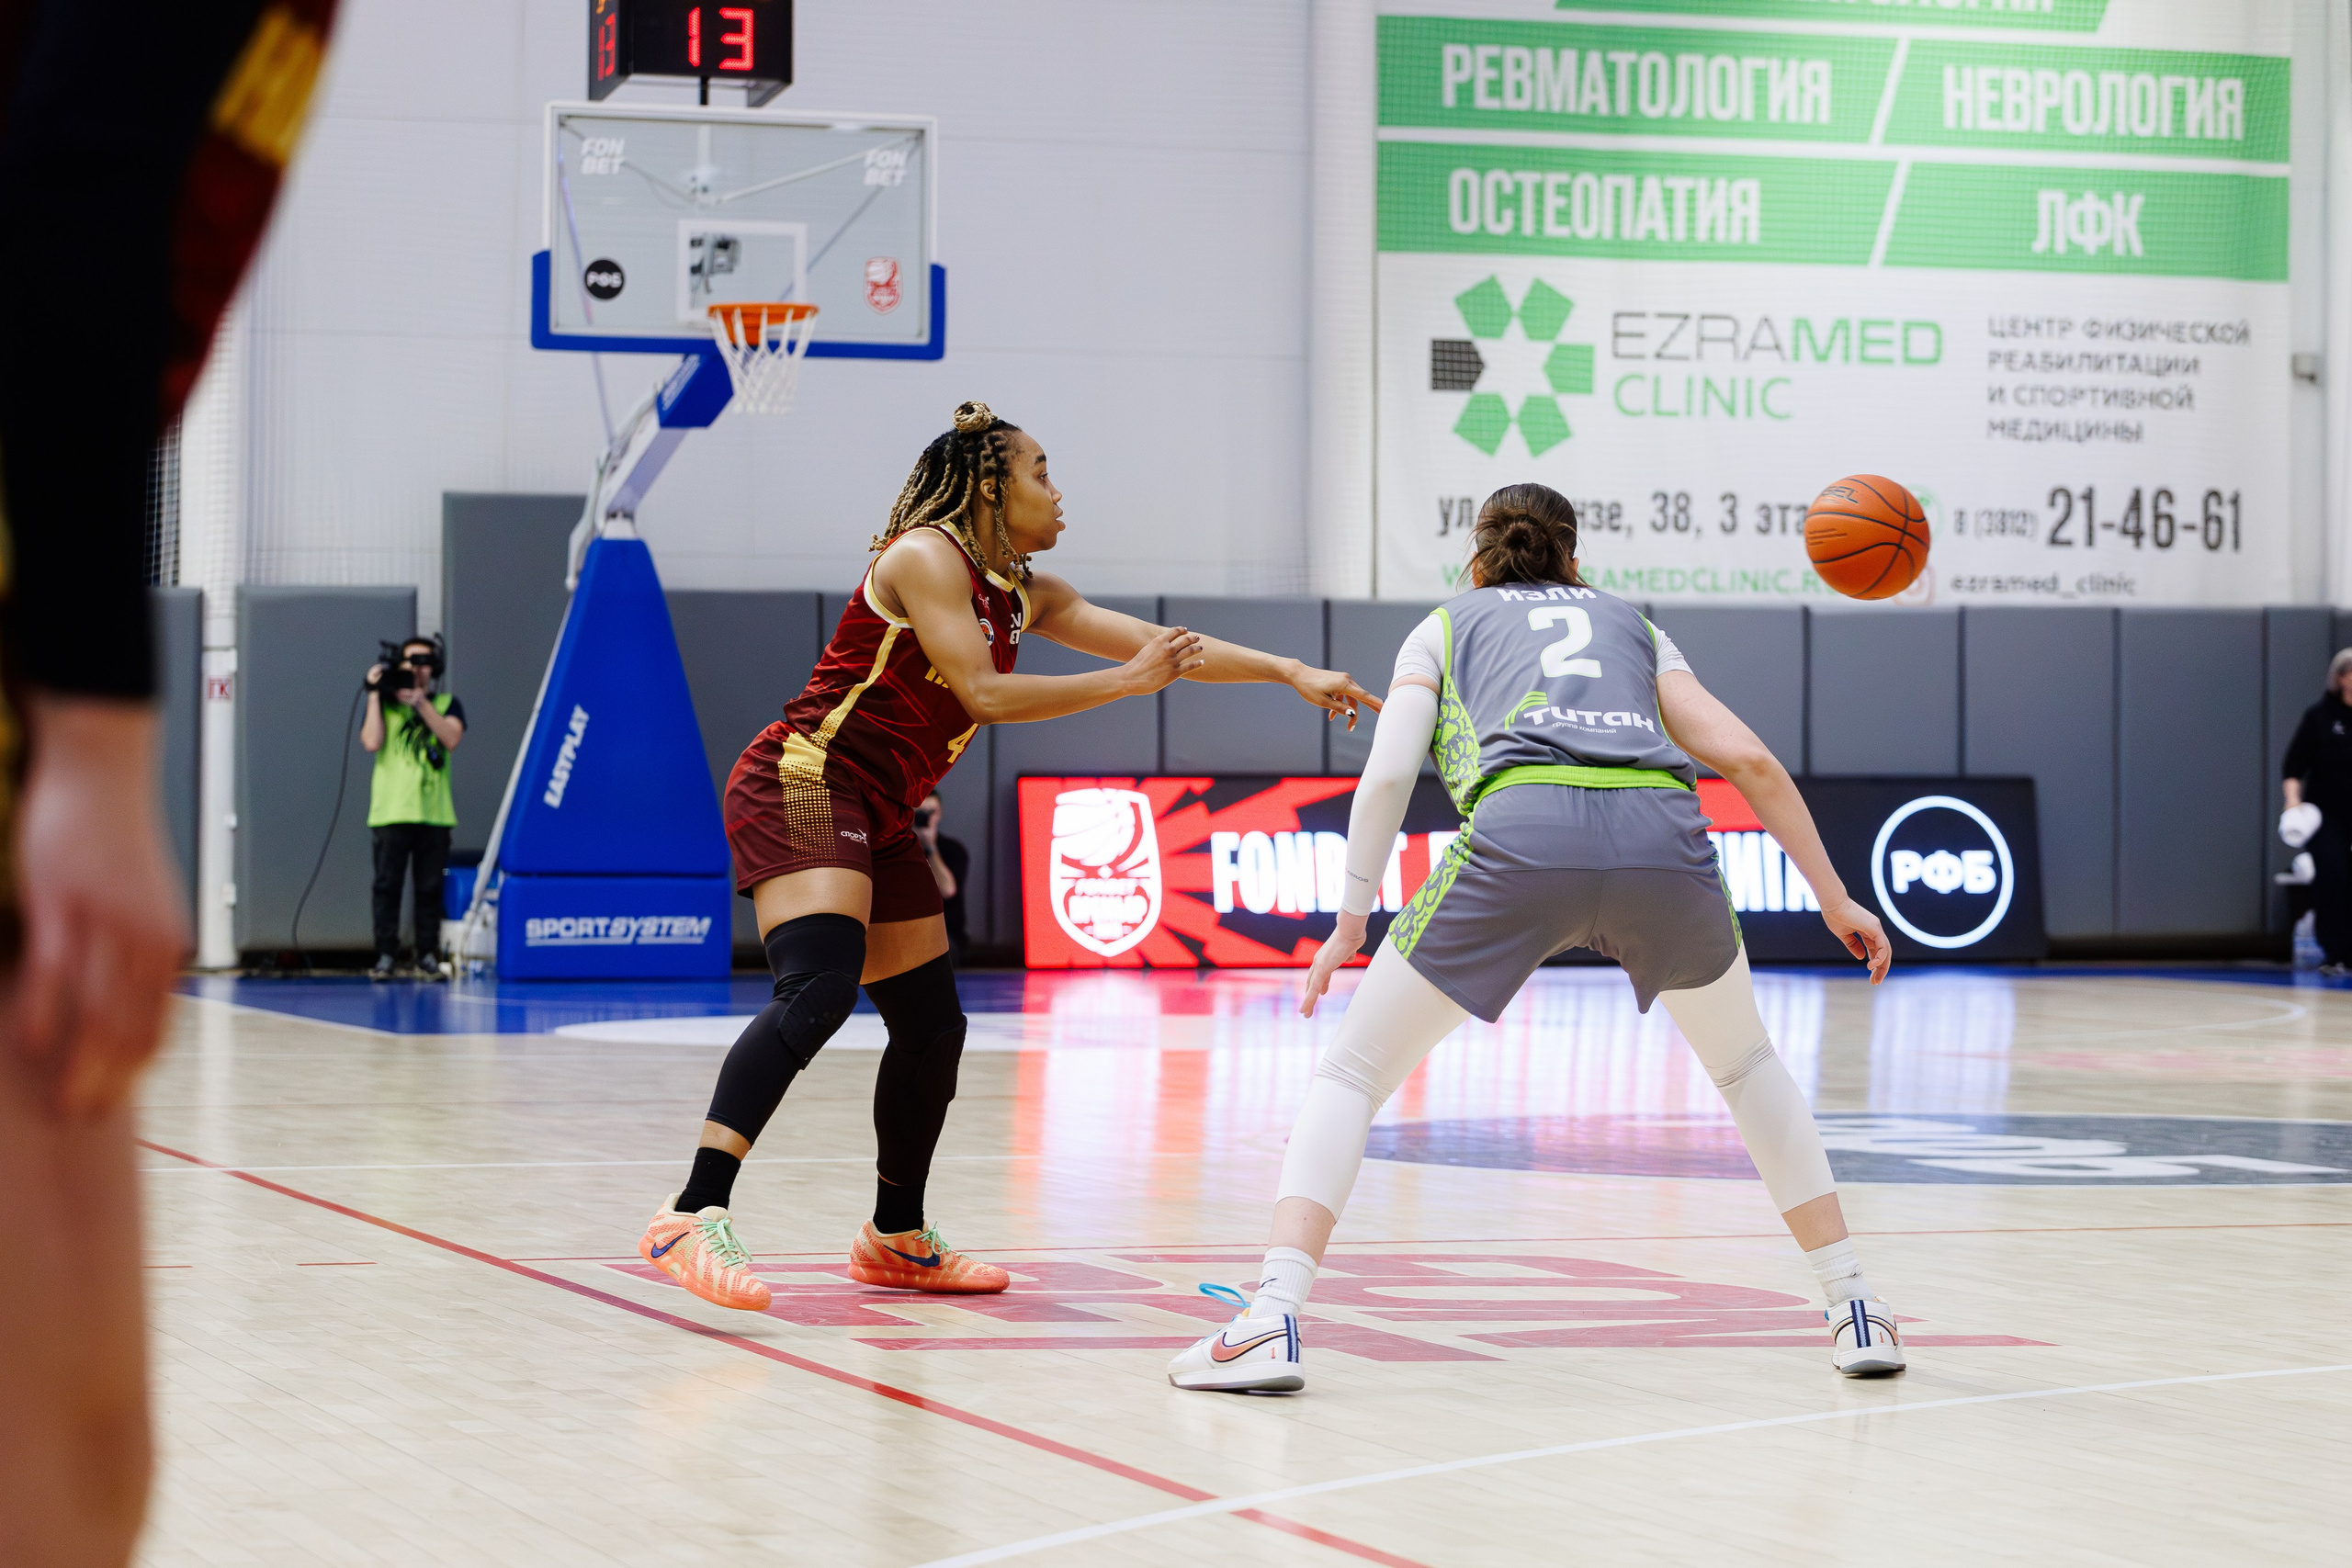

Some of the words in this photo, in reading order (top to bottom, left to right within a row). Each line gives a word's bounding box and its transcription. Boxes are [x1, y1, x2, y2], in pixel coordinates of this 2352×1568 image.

[688, 6, 754, 71] 13
[1442, 42, 1833, 125] РЕВМАТОЛОГИЯ
[1942, 63, 2245, 141] НЕВРОЛОГИЯ
[1448, 167, 1762, 245] ОСТЕОПАТИЯ
[2031, 189, 2144, 258] ЛФК
[1612, 311, 1943, 366] EZRAMED
[1987, 316, 2073, 340] ЦЕНТР
[2082, 318, 2250, 345] ФИЗИЧЕСКОЙ
[1987, 351, 2201, 377] РЕАБИЛИТАЦИИ
[1614, 373, 1792, 420] CLINIC
[1987, 386, 2005, 404] И
[2013, 383, 2196, 411] СПОРТИВНОЙ
[1987, 418, 2144, 444] МЕДИЦИНЫ
[1720, 491, 1737, 535] 3
[2048, 487, 2243, 553] 21-46-61
[1527, 605, 1602, 678] 2
[543, 704, 590, 809] EASTPLAY
[947, 723, 978, 763] 4
[1889, 849, 1997, 895] РФБ
